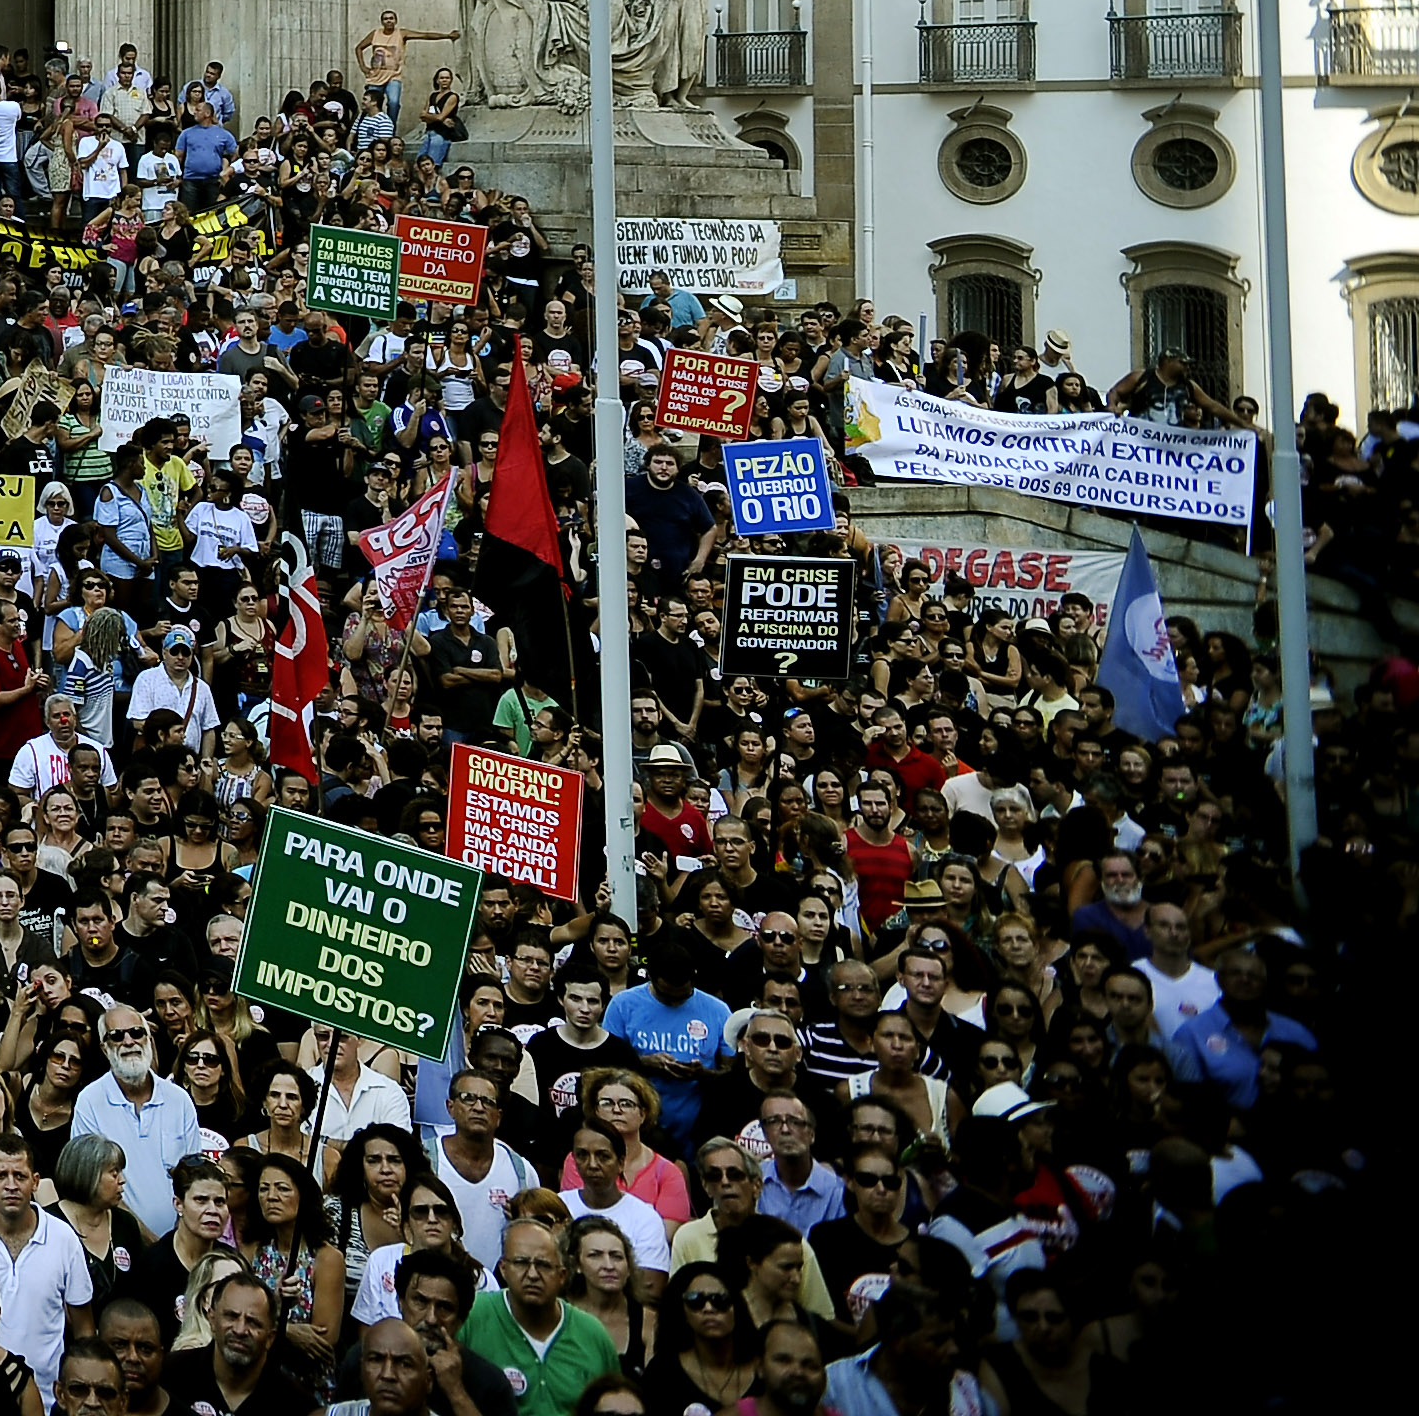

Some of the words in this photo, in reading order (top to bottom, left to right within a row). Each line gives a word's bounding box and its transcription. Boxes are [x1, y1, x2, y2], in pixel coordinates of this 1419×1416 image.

[410, 226, 453, 244] CADÊ
[457, 233, 470, 246] O
[317, 237, 333, 250] 70
[338, 240, 394, 259] BILHÕES
[401, 242, 475, 264] DINHEIRO
[317, 250, 333, 261] EM
[337, 253, 392, 270] IMPOSTOS
[424, 262, 446, 276] DA
[316, 262, 325, 274] E
[329, 263, 358, 279] NÃO
[362, 269, 391, 284] TEM
[316, 275, 361, 290] DINHEIRO
[364, 284, 390, 295] PARA
[399, 277, 472, 296] EDUCAÇÃO?
[313, 286, 325, 300] A
[331, 287, 390, 311] SAÚDE
[673, 355, 709, 372] POR
[714, 362, 750, 378] QUE
[671, 382, 698, 394] PARA
[701, 388, 716, 397] OS
[672, 370, 695, 381] NÃO
[698, 374, 713, 385] HÁ
[716, 378, 748, 390] CRISE
[668, 402, 688, 412] DAS
[670, 391, 710, 406] GASTOS
[719, 390, 747, 421] ?
[664, 413, 743, 434] OLIMPÍADAS
[897, 415, 999, 447] LUTAMOS
[1002, 433, 1091, 456] CONTRA
[1092, 439, 1106, 457] A
[1112, 442, 1246, 475] EXTINÇÃO
[735, 451, 815, 479] PEZÃO
[739, 477, 817, 497] QUEBROU
[742, 498, 763, 524] O
[771, 494, 821, 522] RIO
[743, 567, 775, 581] EM
[782, 568, 839, 583] CRISE
[741, 582, 838, 607] PODE
[740, 608, 838, 623] REFORMAR
[738, 623, 749, 634] A
[754, 623, 813, 636] PISCINA
[818, 626, 838, 636] DO
[737, 637, 837, 650] GOVERNADOR
[774, 652, 798, 673] ?
[468, 754, 563, 789] GOVERNO
[468, 768, 560, 805] IMORAL:
[466, 789, 560, 826] ESTAMOS
[466, 805, 491, 824] EM
[464, 820, 503, 842] MAS
[507, 832, 558, 856] ANDA
[464, 834, 491, 852] EM
[495, 843, 556, 870] CARRO
[283, 831, 365, 879] PARA
[373, 858, 464, 909] ONDE
[462, 848, 557, 889] OFICIAL!
[325, 877, 374, 916] VAI
[382, 896, 408, 925] O
[285, 899, 432, 967] DINHEIRO
[317, 945, 385, 989] DOS
[256, 959, 436, 1039] IMPOSTOS?
